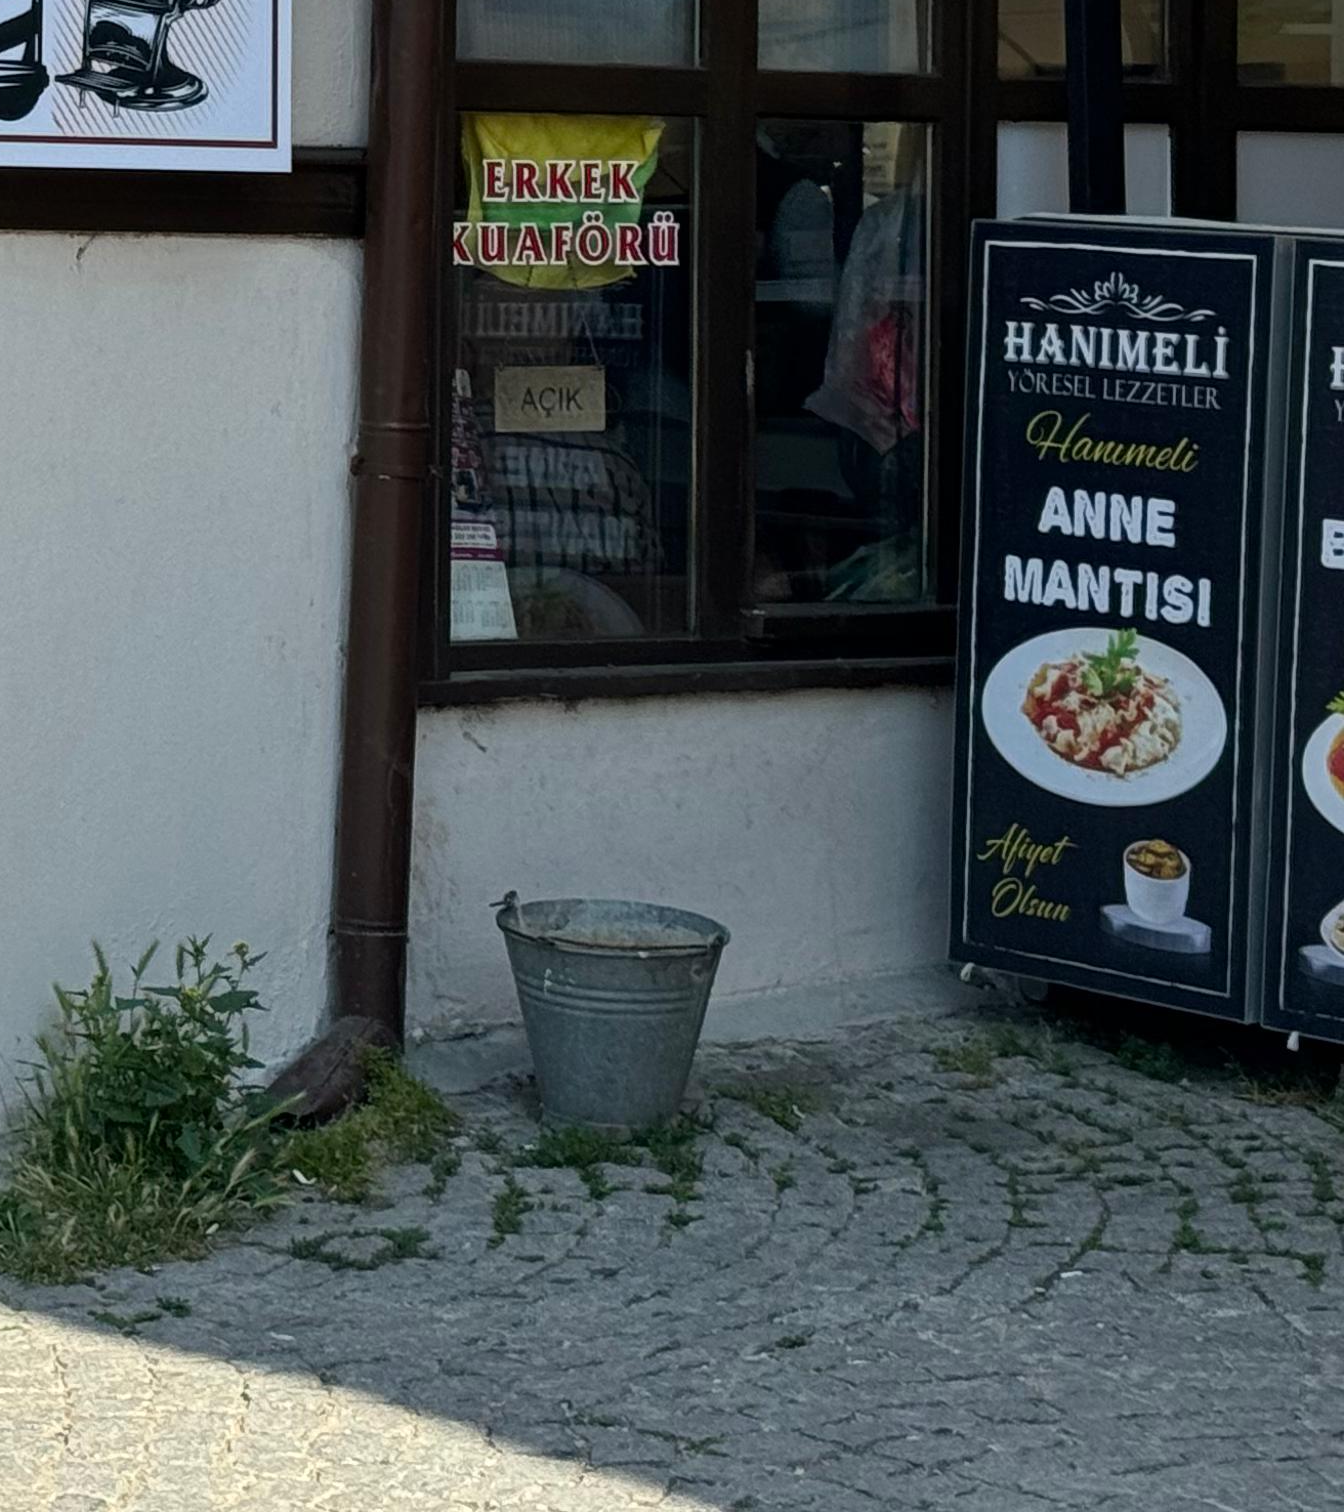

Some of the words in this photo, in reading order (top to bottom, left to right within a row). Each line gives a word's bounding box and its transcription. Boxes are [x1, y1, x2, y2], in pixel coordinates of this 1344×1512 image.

[483, 159, 640, 203] ERKEK
[453, 211, 680, 266] KUAFÖRÜ
[1003, 320, 1229, 380] HANIMELİ
[520, 387, 584, 417] AÇIK
[1008, 368, 1096, 399] YÖRESEL
[1102, 377, 1221, 411] LEZZETLER
[1038, 486, 1176, 549] ANNE
[1004, 554, 1212, 628] MANTISI
[977, 822, 1080, 879] Afiyet
[992, 877, 1070, 922] Olsun
